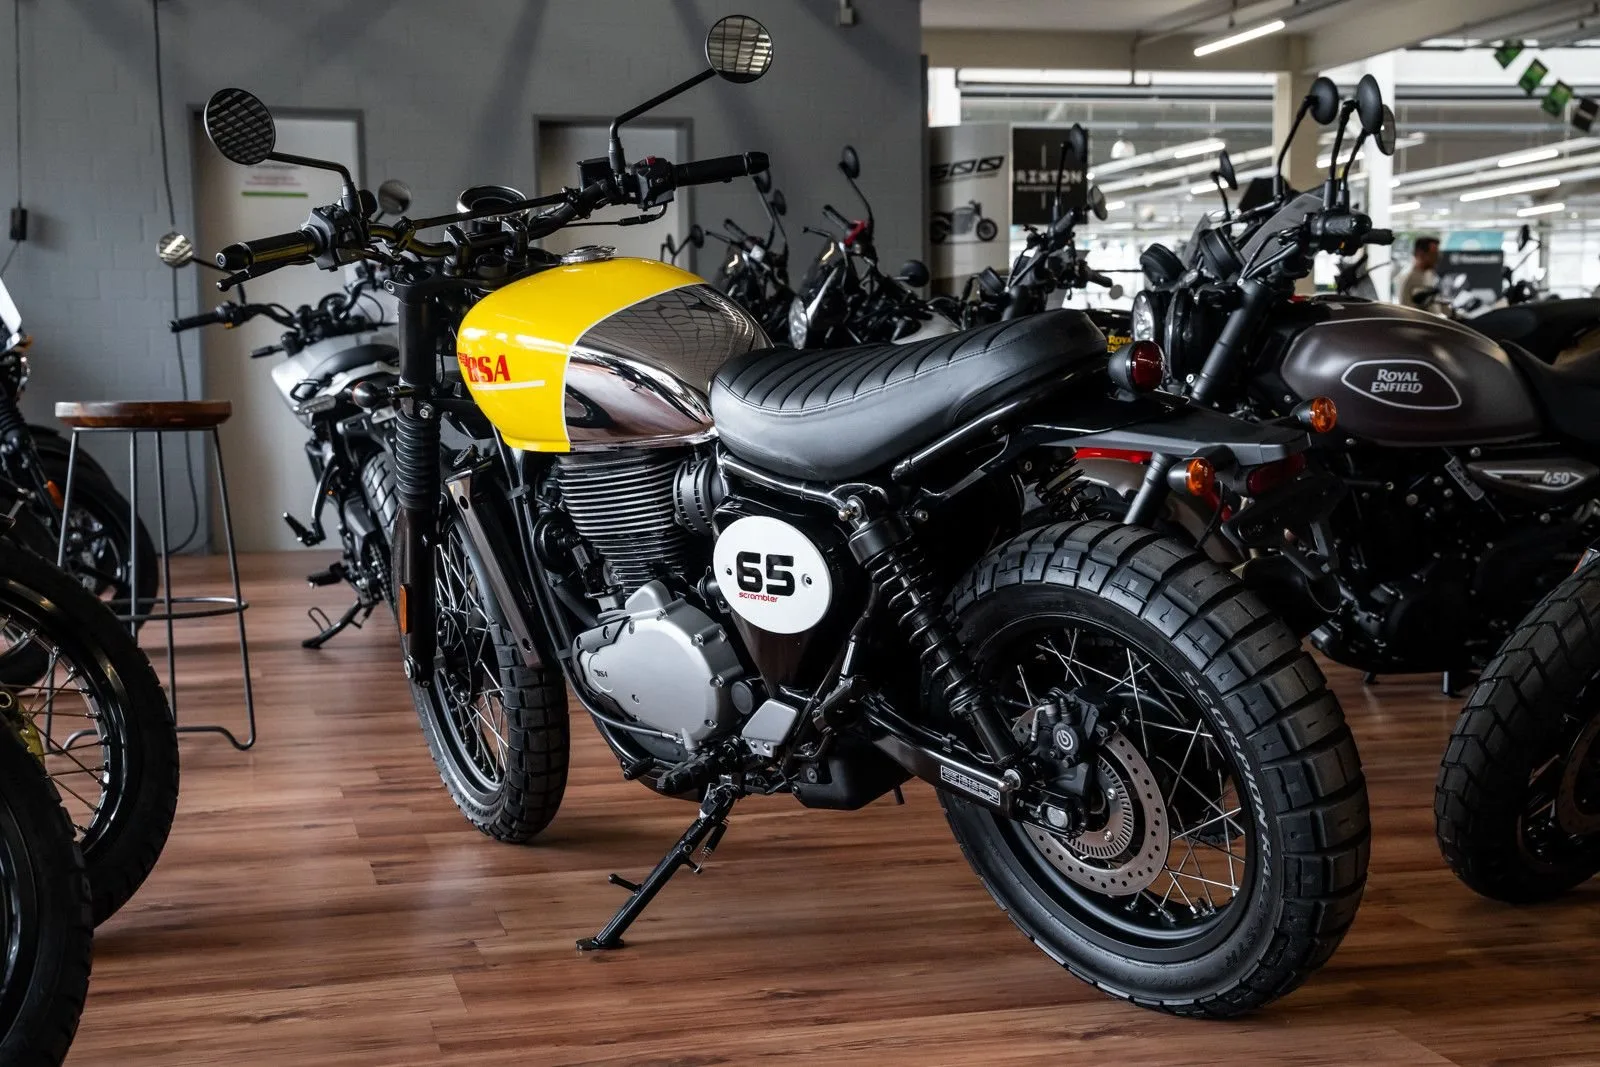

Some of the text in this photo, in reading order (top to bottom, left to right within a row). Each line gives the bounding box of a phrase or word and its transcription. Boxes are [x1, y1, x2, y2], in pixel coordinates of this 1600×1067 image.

[1015, 168, 1083, 185] RIXTON
[1108, 335, 1133, 345] ROYA
[466, 354, 511, 383] BSA
[1377, 368, 1419, 382] ROYAL
[1370, 382, 1423, 394] ENFIELD
[1542, 471, 1570, 484] 450
[736, 550, 796, 597] 65
[738, 591, 778, 603] scrambler
[1180, 671, 1269, 830] SCORPION
